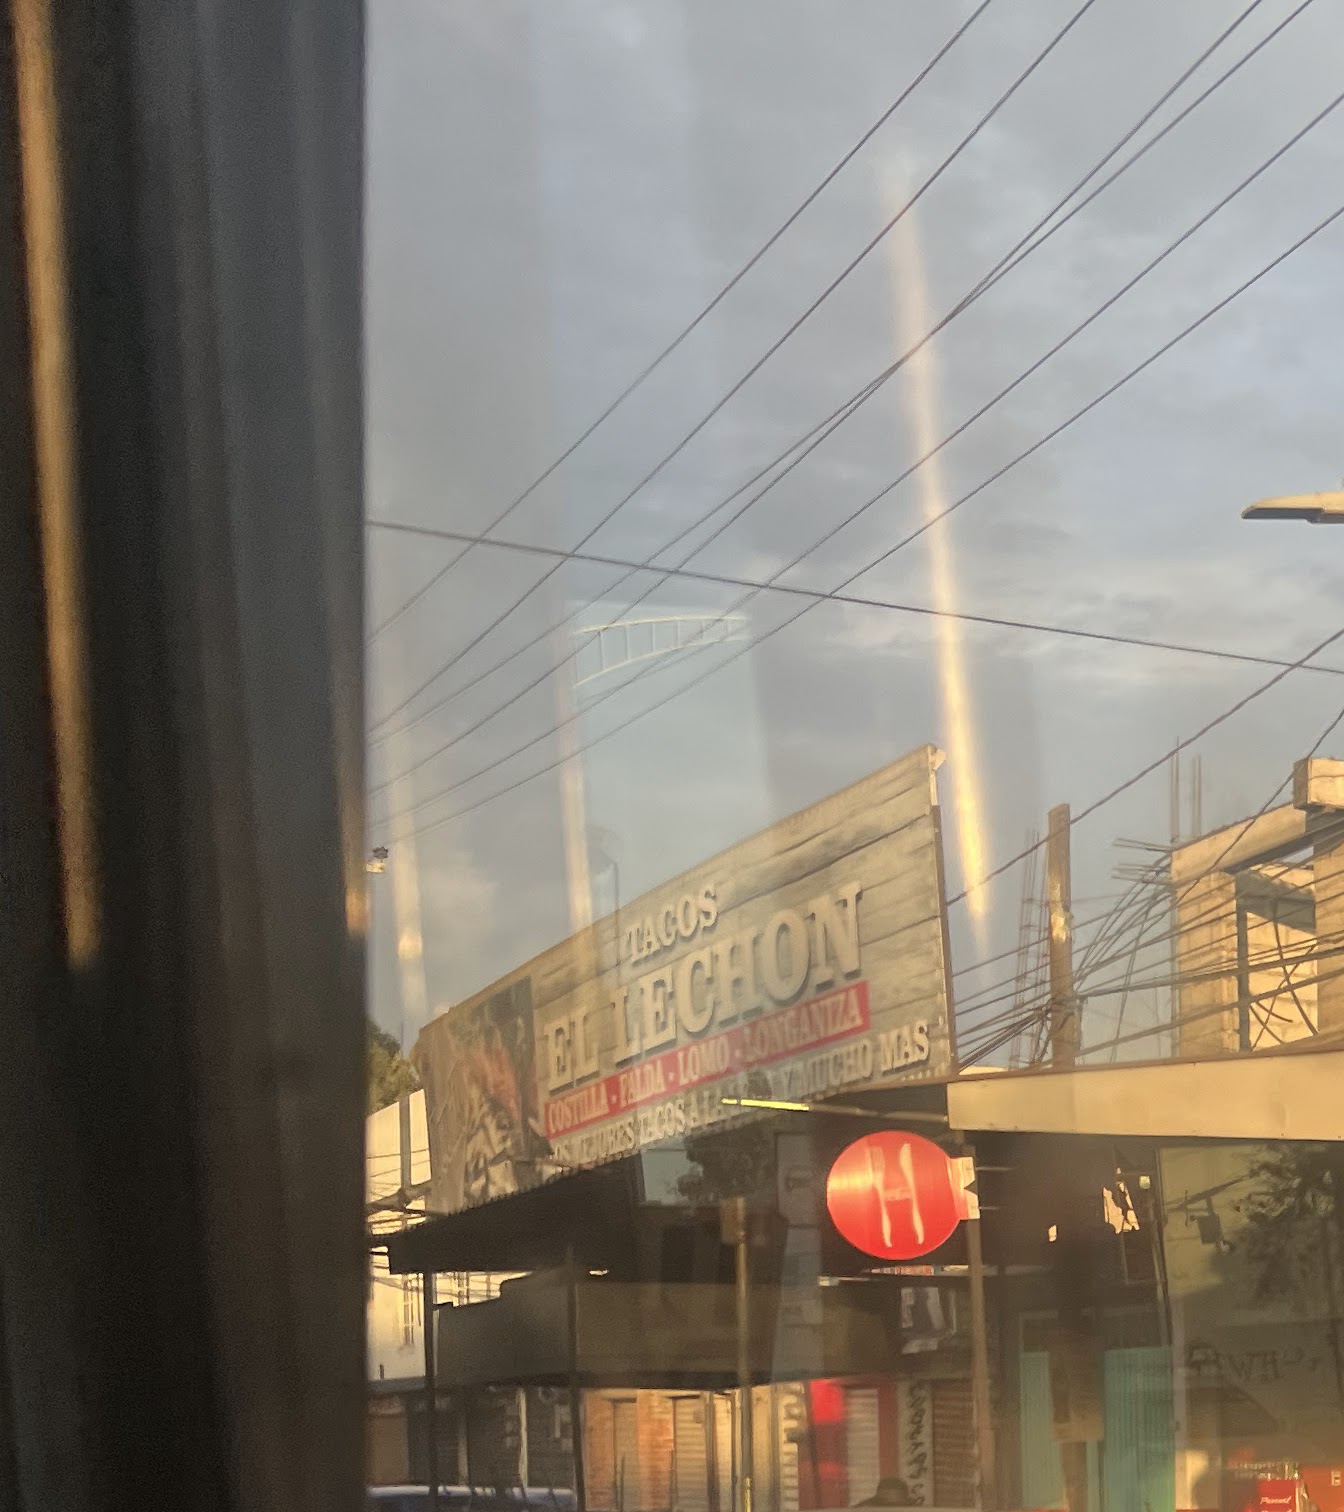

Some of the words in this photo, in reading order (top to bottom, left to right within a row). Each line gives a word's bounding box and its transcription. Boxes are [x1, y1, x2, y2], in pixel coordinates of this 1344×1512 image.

[626, 883, 719, 965] TACOS
[542, 1009, 600, 1093] EL
[613, 883, 864, 1068] LECHON
[549, 1082, 609, 1133] COSTILLA
[677, 1037, 730, 1086] LOMO
[743, 989, 863, 1061] LONGANIZA
[880, 1020, 929, 1072] MAS
